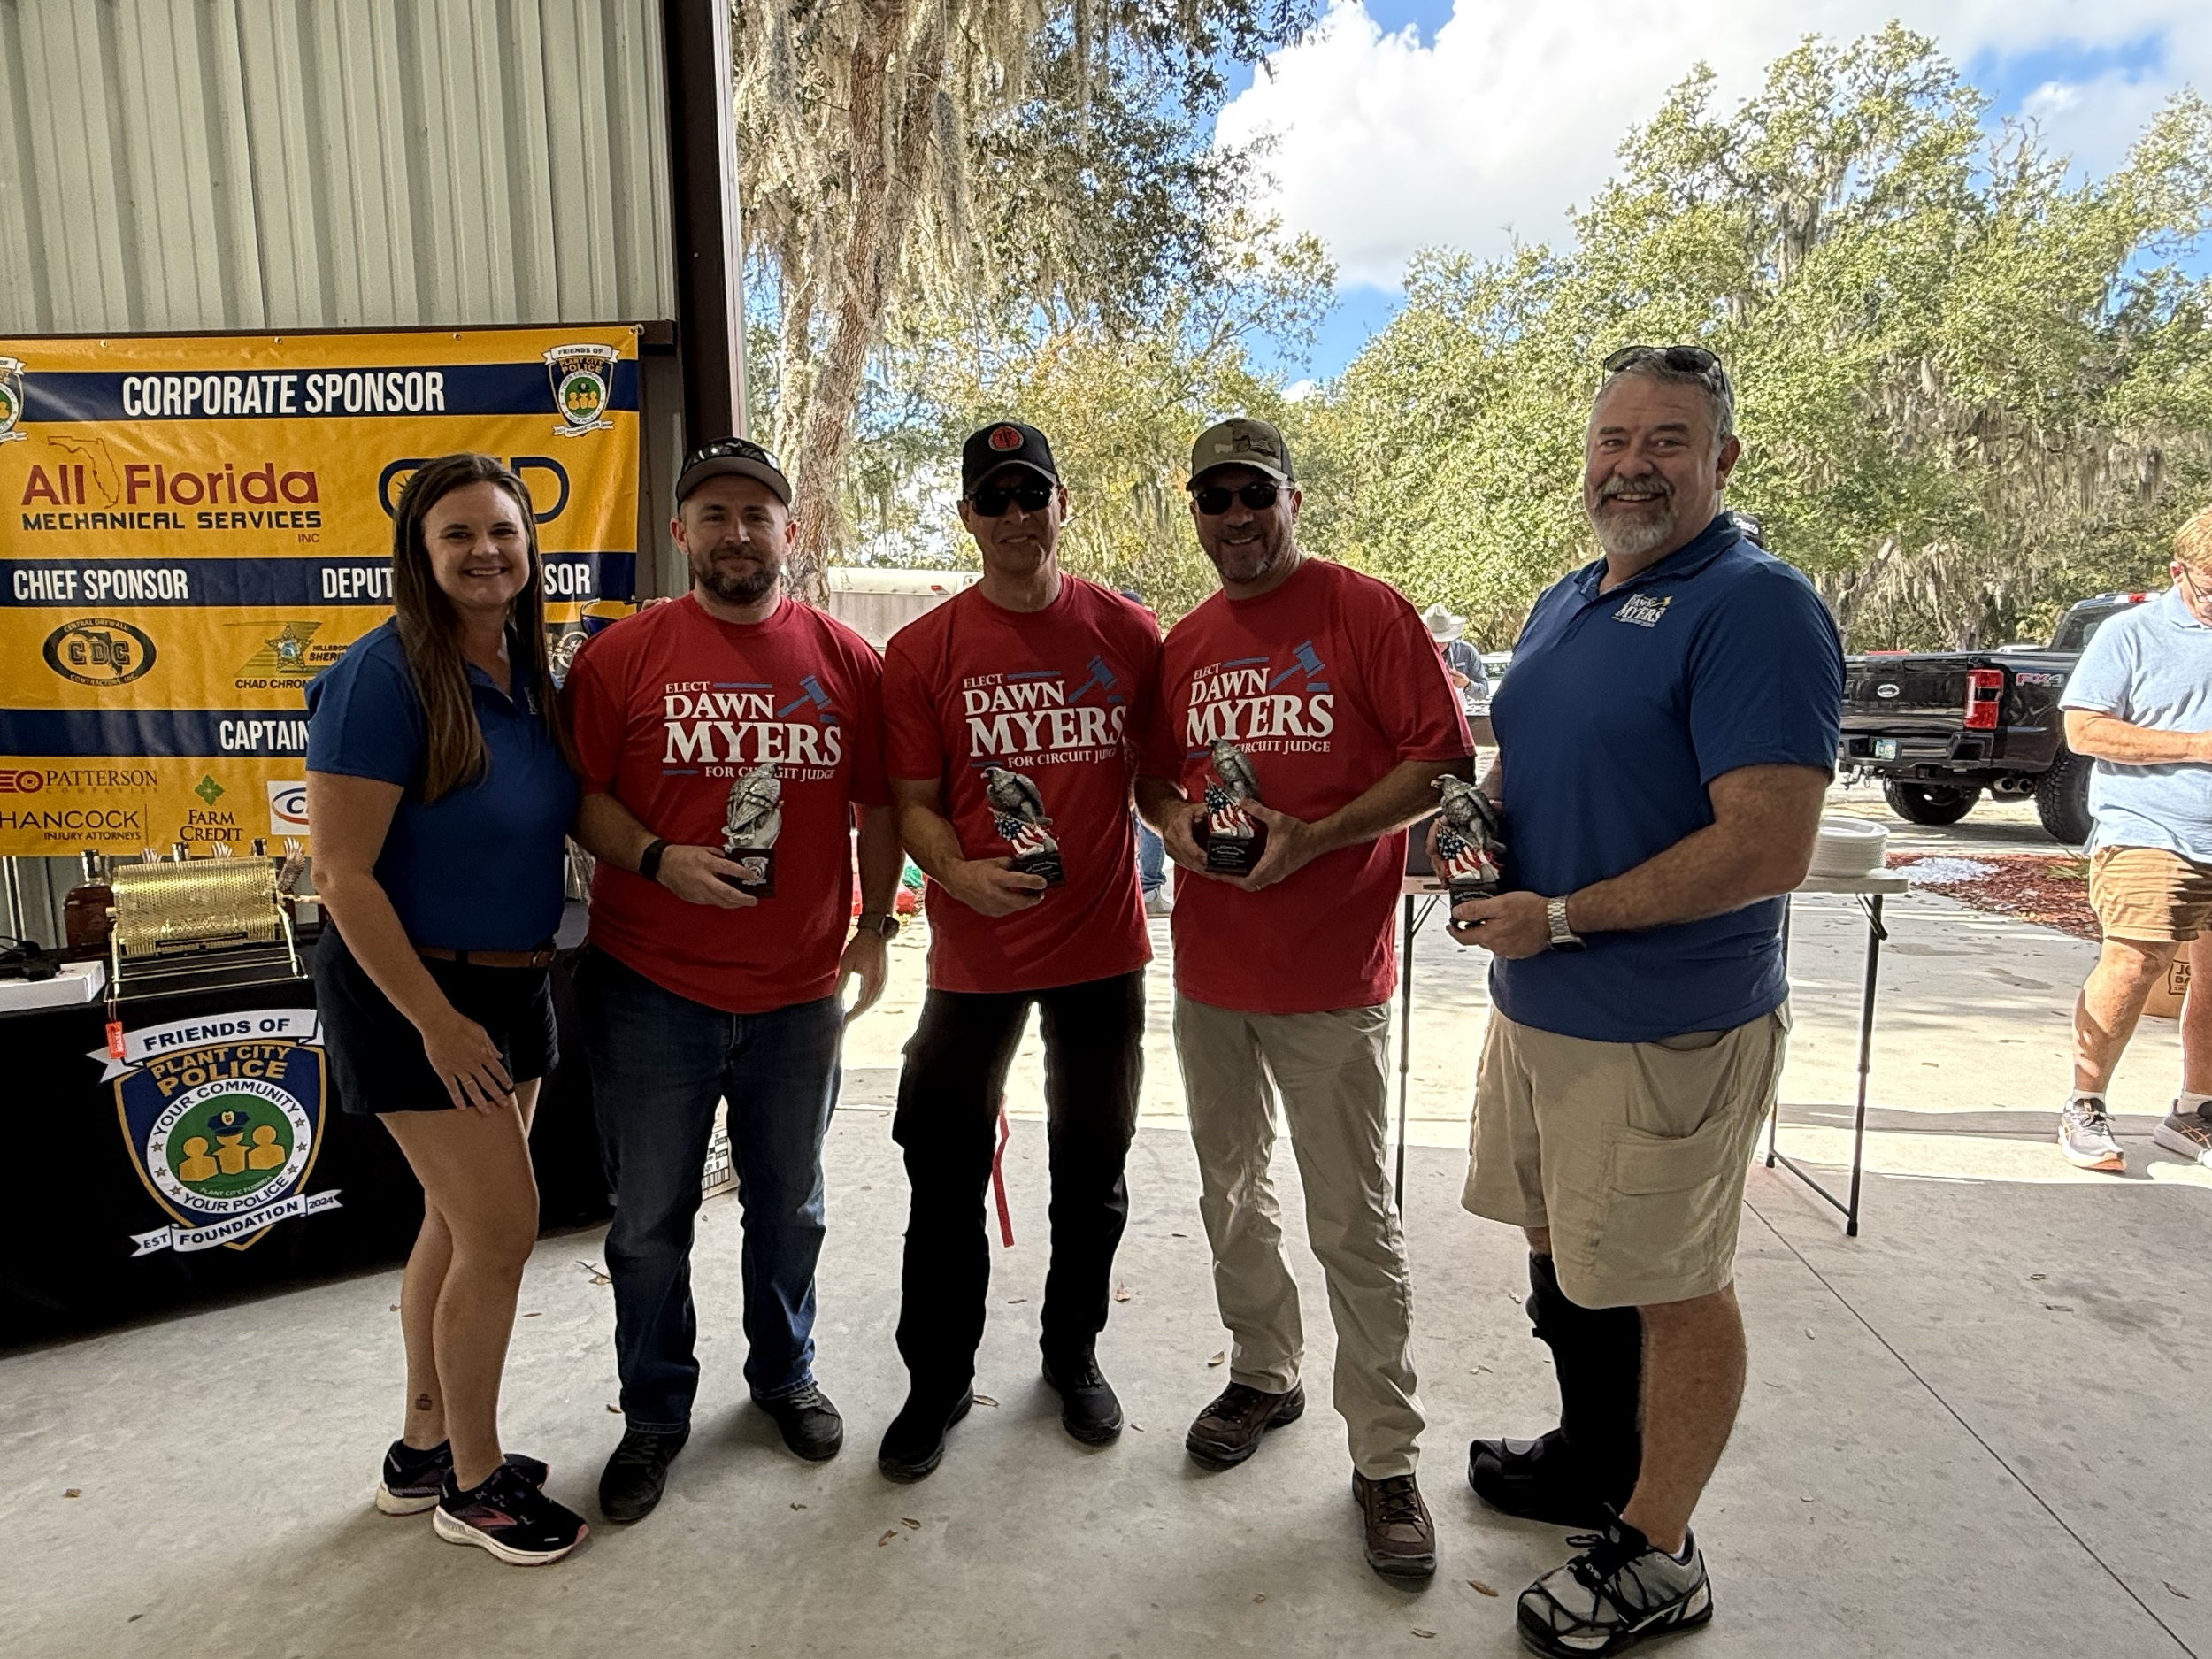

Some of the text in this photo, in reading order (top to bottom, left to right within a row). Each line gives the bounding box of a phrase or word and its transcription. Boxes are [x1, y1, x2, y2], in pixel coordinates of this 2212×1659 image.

[562, 364, 603, 375] POLICE
[123, 371, 445, 417] CORPORATE SPONSOR
[21, 462, 319, 506] All Florida
[22, 510, 322, 531] MECHANICAL SERVICES
[297, 533, 320, 543] INC
[13, 568, 189, 601] CHIEF SPONSOR
[322, 567, 395, 599] DEPUT
[63, 618, 94, 633] CENTRAL
[68, 641, 130, 665] CDC
[963, 672, 1003, 689] ELECT
[1194, 662, 1222, 680] ELECT
[2016, 672, 2065, 687] FX4
[234, 679, 267, 689] CHAD
[665, 680, 710, 694] ELECT
[1188, 667, 1271, 707] DAWN
[663, 692, 776, 721] DAWN
[962, 680, 1066, 717] DAWN
[965, 704, 1127, 757] MYERS
[1186, 694, 1334, 748] MYERS
[662, 720, 841, 767] MYERS
[1283, 741, 1331, 756] JUDGE
[1008, 756, 1035, 769] FOR
[1037, 749, 1093, 765] CIRCUIT
[47, 769, 158, 787] PATTERSON
[705, 765, 734, 779] FOR
[799, 768, 835, 783] JUDGE
[0, 810, 140, 830] HANCOCK
[188, 809, 235, 825] FARM
[44, 831, 141, 841] INJURY ATTORNEYS
[180, 825, 243, 841] CREDIT
[143, 1020, 251, 1052] FRIENDS
[259, 1018, 291, 1033] OF
[150, 1045, 292, 1081] PLANT CITY
[157, 1059, 288, 1099] POLICE
[153, 1080, 301, 1138] YOUR COMMUNITY
[182, 1175, 290, 1212] YOUR POLICE
[142, 1195, 334, 1250] EST FOUNDATION 2024
